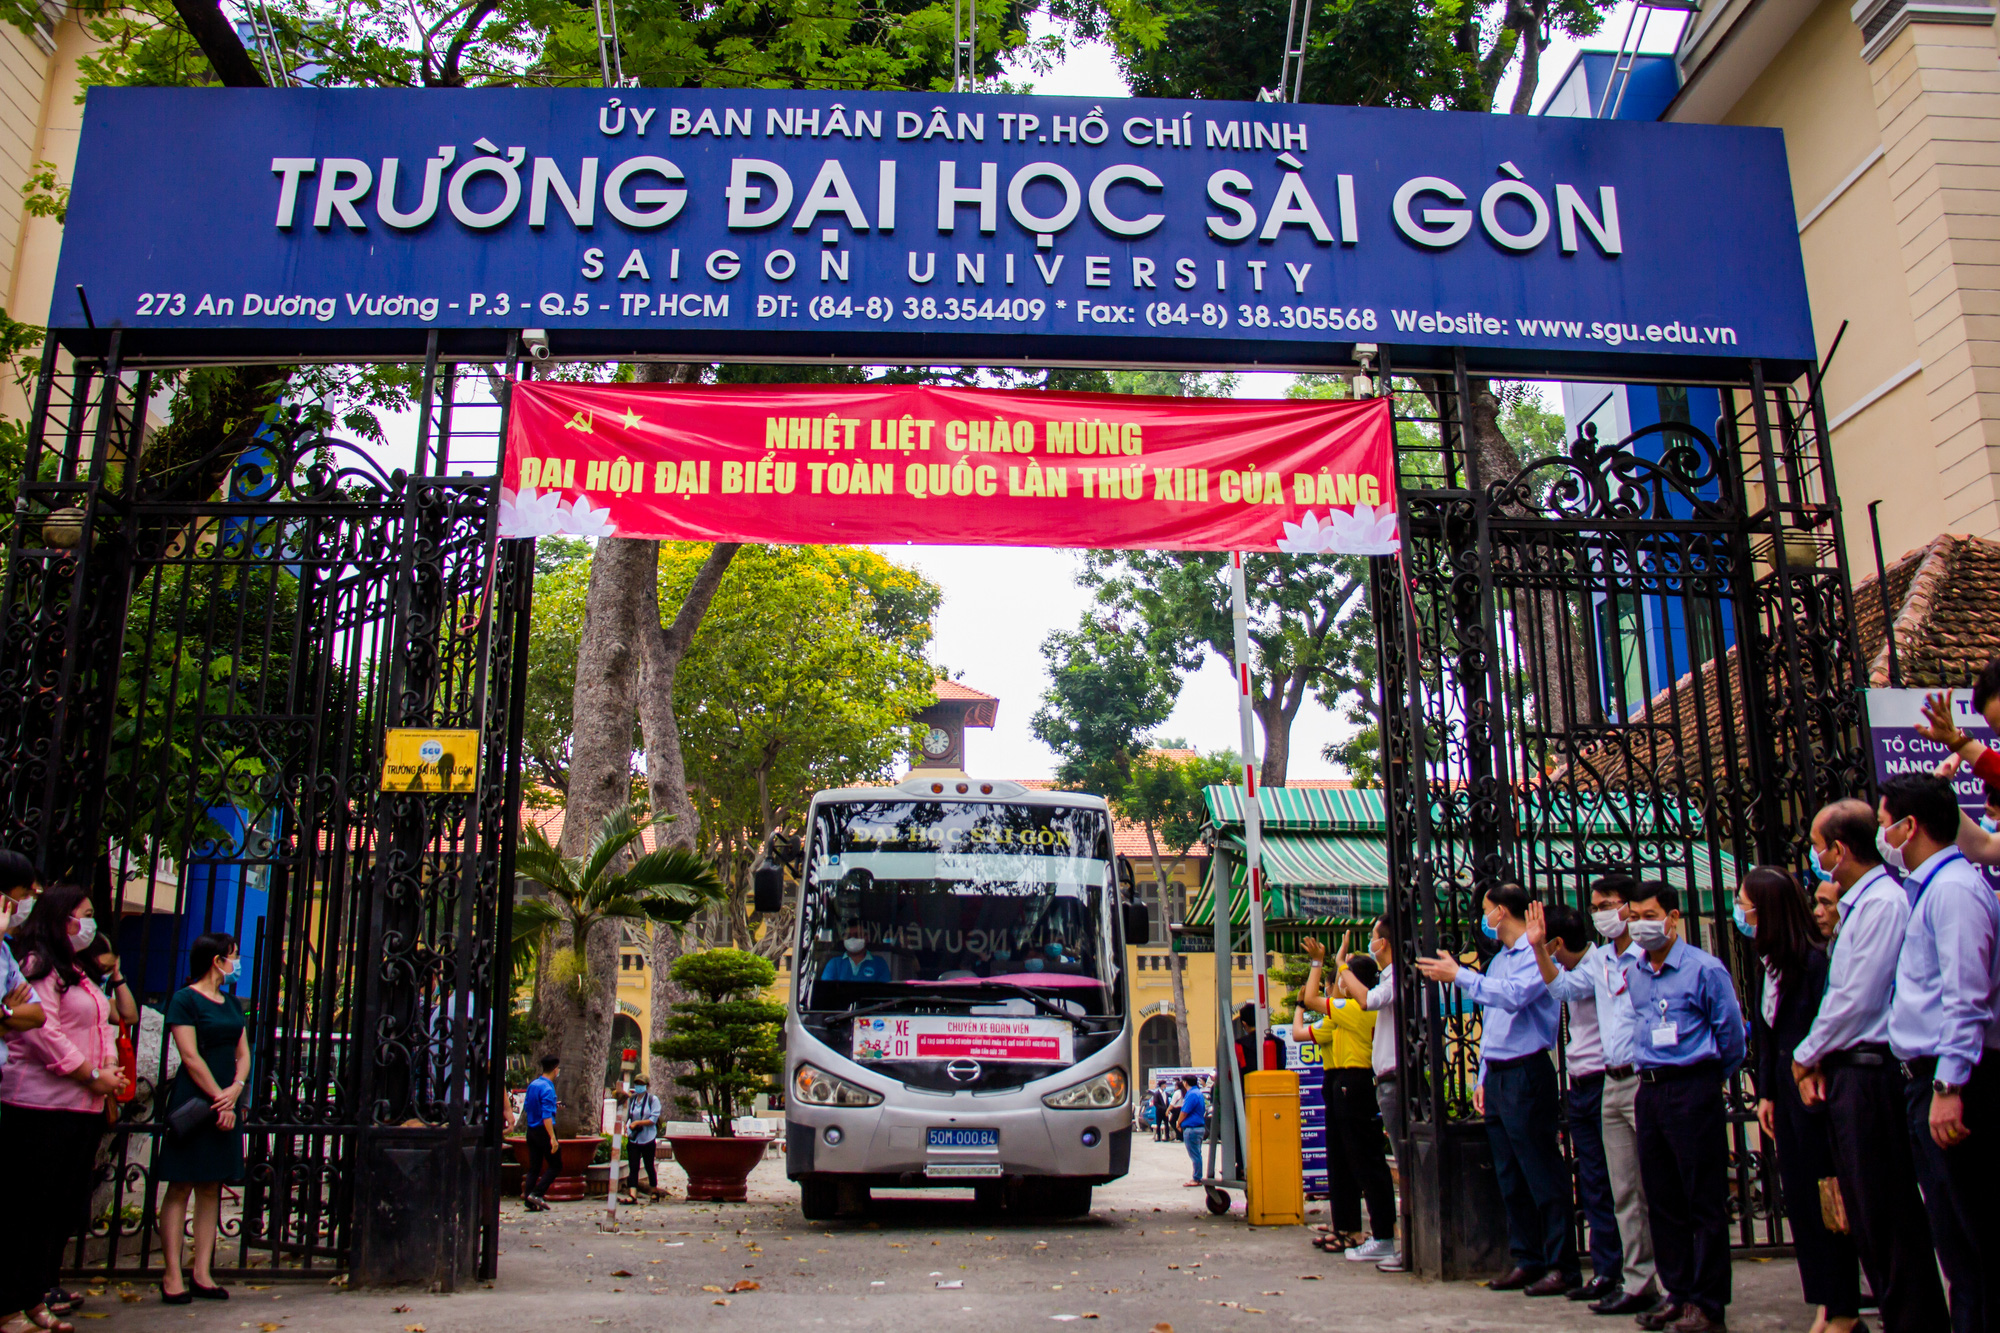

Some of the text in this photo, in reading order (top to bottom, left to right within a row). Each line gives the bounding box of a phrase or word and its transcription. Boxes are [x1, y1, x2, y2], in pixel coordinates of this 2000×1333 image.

[600, 98, 655, 134] ỦY
[670, 109, 752, 135] BAN
[767, 103, 882, 137] NHÂN
[897, 106, 984, 140] DÂN
[1123, 112, 1192, 146] CHÍ
[1206, 120, 1307, 150] MINH
[272, 138, 1622, 254] TRƯỜNG ĐẠI HỌC SÀI GÒN
[582, 248, 1312, 293] SAIGON UNIVERSITY
[137, 293, 186, 316] 273
[194, 293, 234, 316] An
[243, 293, 337, 322] Dương
[346, 293, 439, 322] Vương
[469, 293, 510, 316] P.3
[539, 293, 590, 316] Q.5
[620, 293, 729, 317] TP.HCM
[757, 294, 798, 318] ĐT:
[809, 296, 894, 322] (84-8)
[903, 297, 1046, 321] 38.354409
[1077, 300, 1135, 323] Fax:
[1146, 302, 1228, 329] (84-8)
[1238, 305, 1378, 331] 38.305568
[1391, 309, 1509, 336] Website:
[1516, 318, 1737, 346] www.sgu.edu.vn
[765, 412, 1143, 456] NHIỆT LIỆT CHÀO MỪNG
[520, 451, 1380, 506] ĐẠI HỘI ĐẠI BIỂU TOÀN QUỐC LẦN THỨ XIII CỦA ĐẢNG
[1882, 735, 1904, 752] TỔ
[1885, 757, 1934, 774] NĂNG
[895, 1020, 909, 1036] XE
[895, 1040, 909, 1056] 01
[979, 1022, 988, 1033] XE
